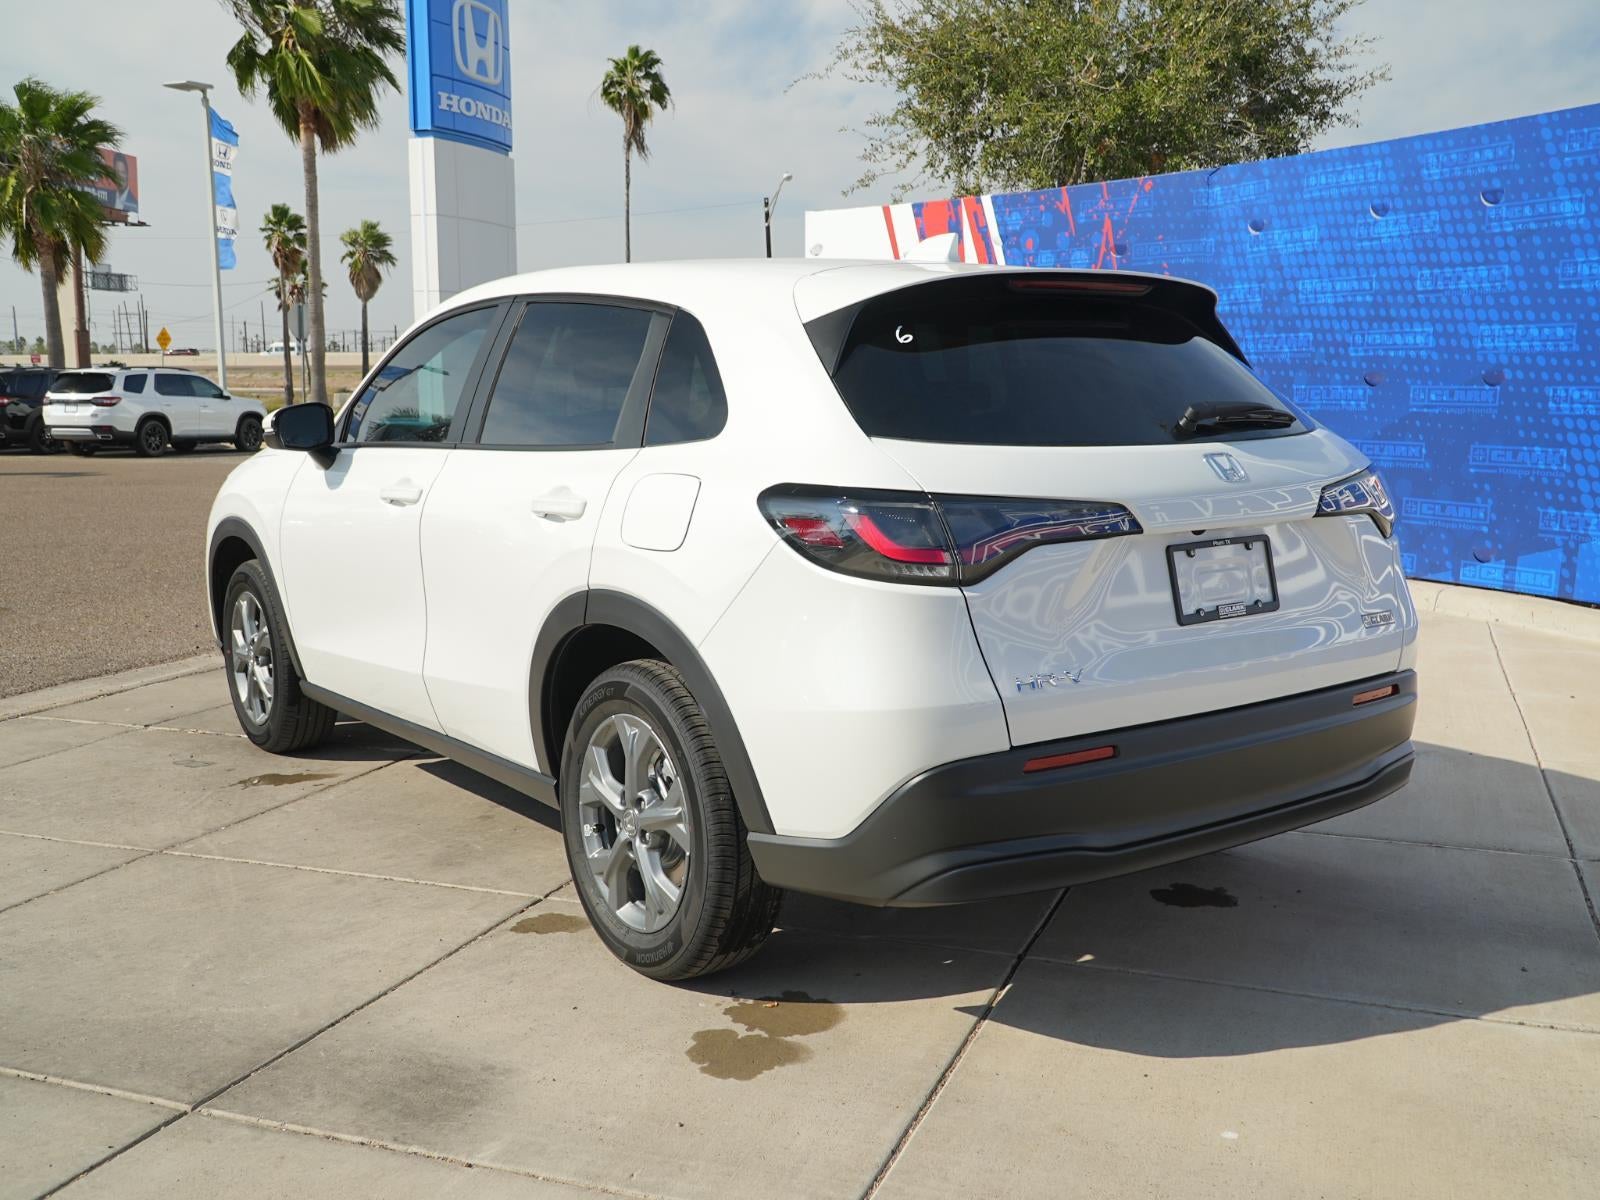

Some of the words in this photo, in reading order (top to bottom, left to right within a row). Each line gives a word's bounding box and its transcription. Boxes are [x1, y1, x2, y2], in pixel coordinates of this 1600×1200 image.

[437, 91, 512, 130] HONDA
[895, 325, 914, 343] 6
[1429, 388, 1497, 402] CLARK
[1490, 449, 1562, 466] CLARK
[1420, 502, 1487, 521] CLARK
